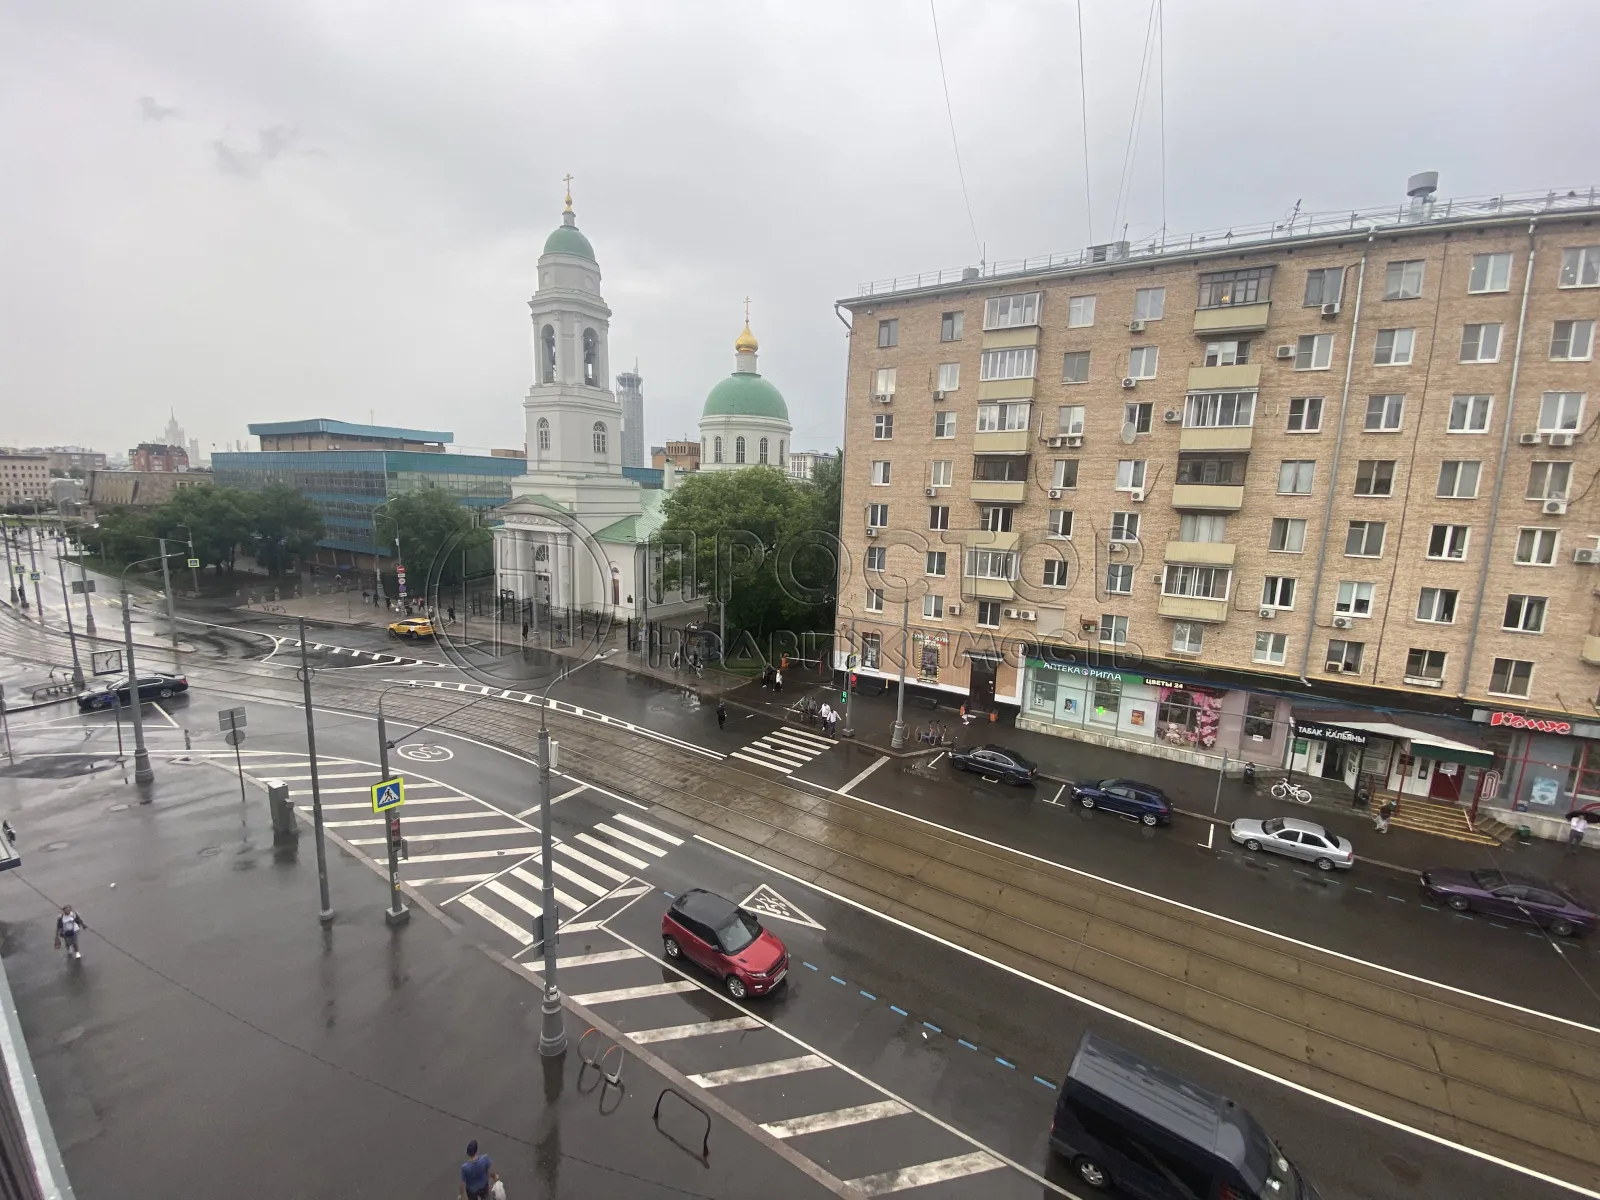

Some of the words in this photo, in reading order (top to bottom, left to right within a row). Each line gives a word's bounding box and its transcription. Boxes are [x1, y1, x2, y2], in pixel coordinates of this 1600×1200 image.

[1043, 662, 1081, 675] АПТЕКА
[1091, 669, 1122, 681] РИГЛА
[1145, 679, 1173, 688] ЦВЕТЫ
[1298, 726, 1323, 736] ТАБАК
[1325, 730, 1366, 744] КАЛЬЯНЫ
